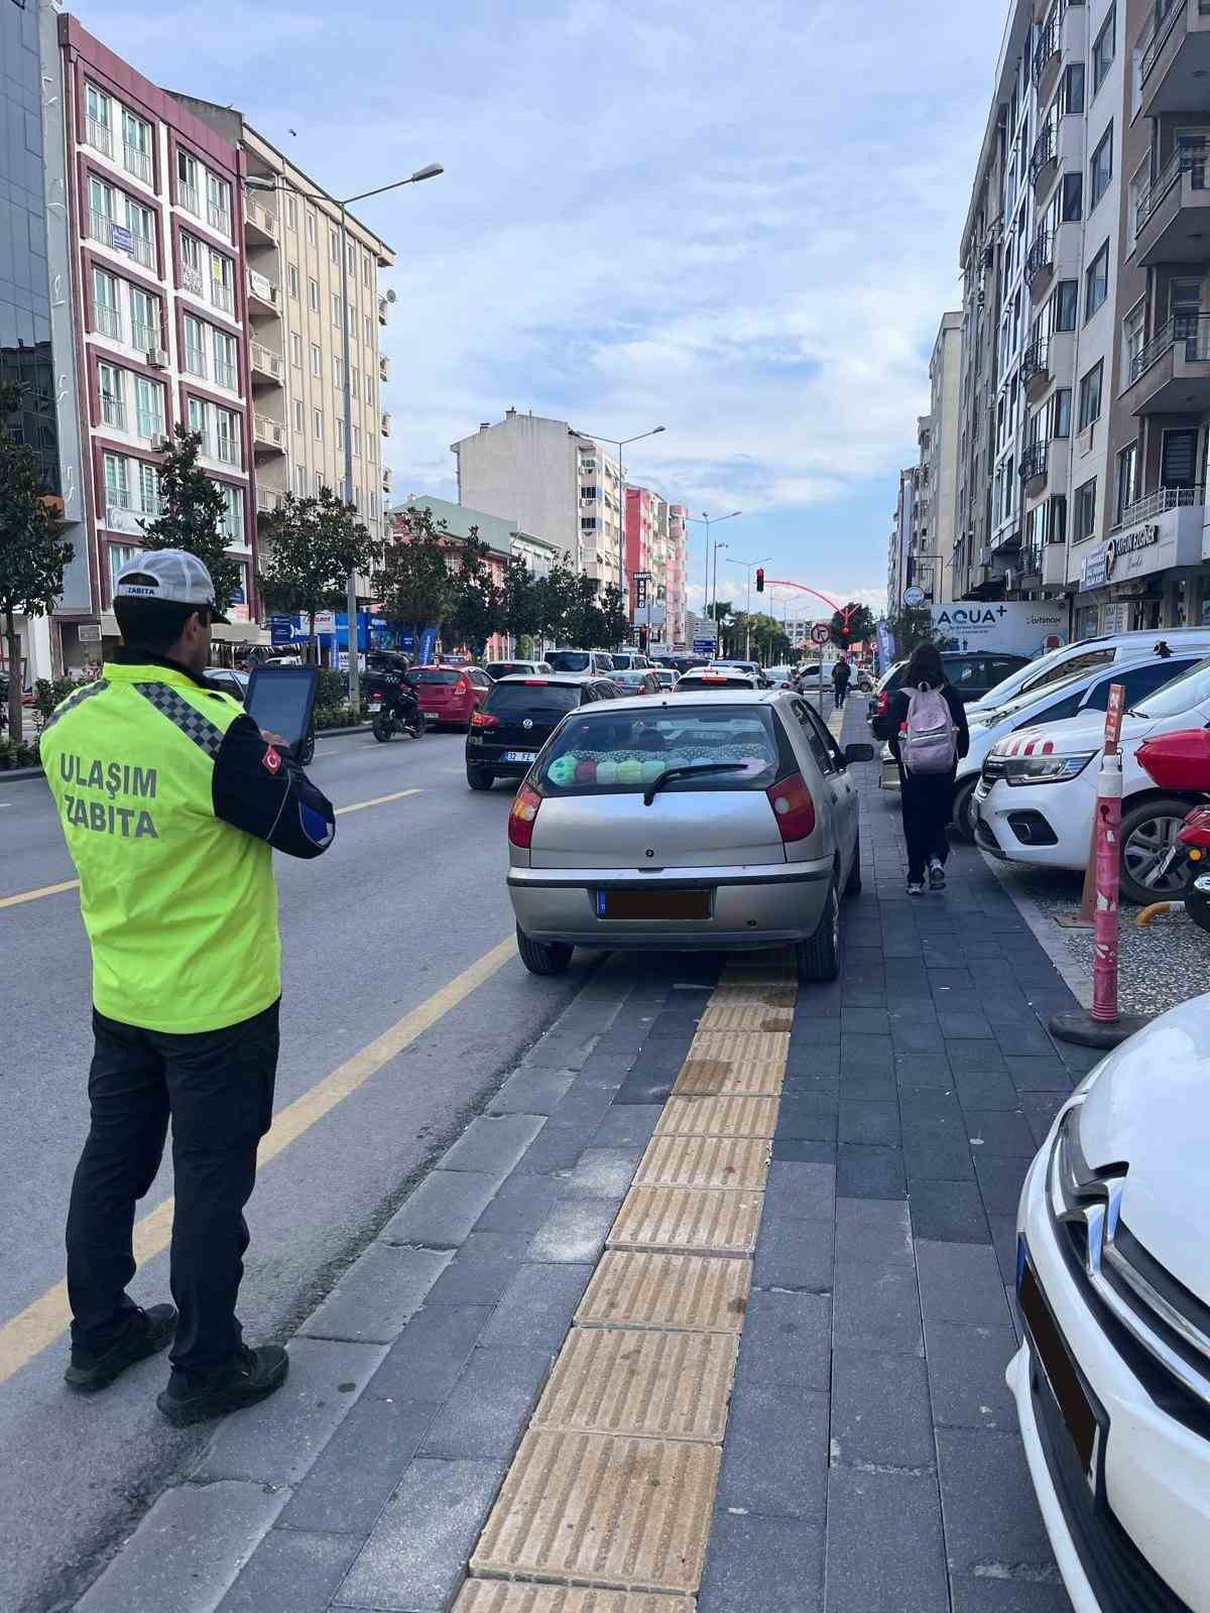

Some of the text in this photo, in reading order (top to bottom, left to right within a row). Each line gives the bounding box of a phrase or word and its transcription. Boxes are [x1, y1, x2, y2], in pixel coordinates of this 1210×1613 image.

[128, 586, 155, 595] ZABITA
[60, 753, 157, 799] ULAŞIM
[63, 795, 159, 838] ZABITA
